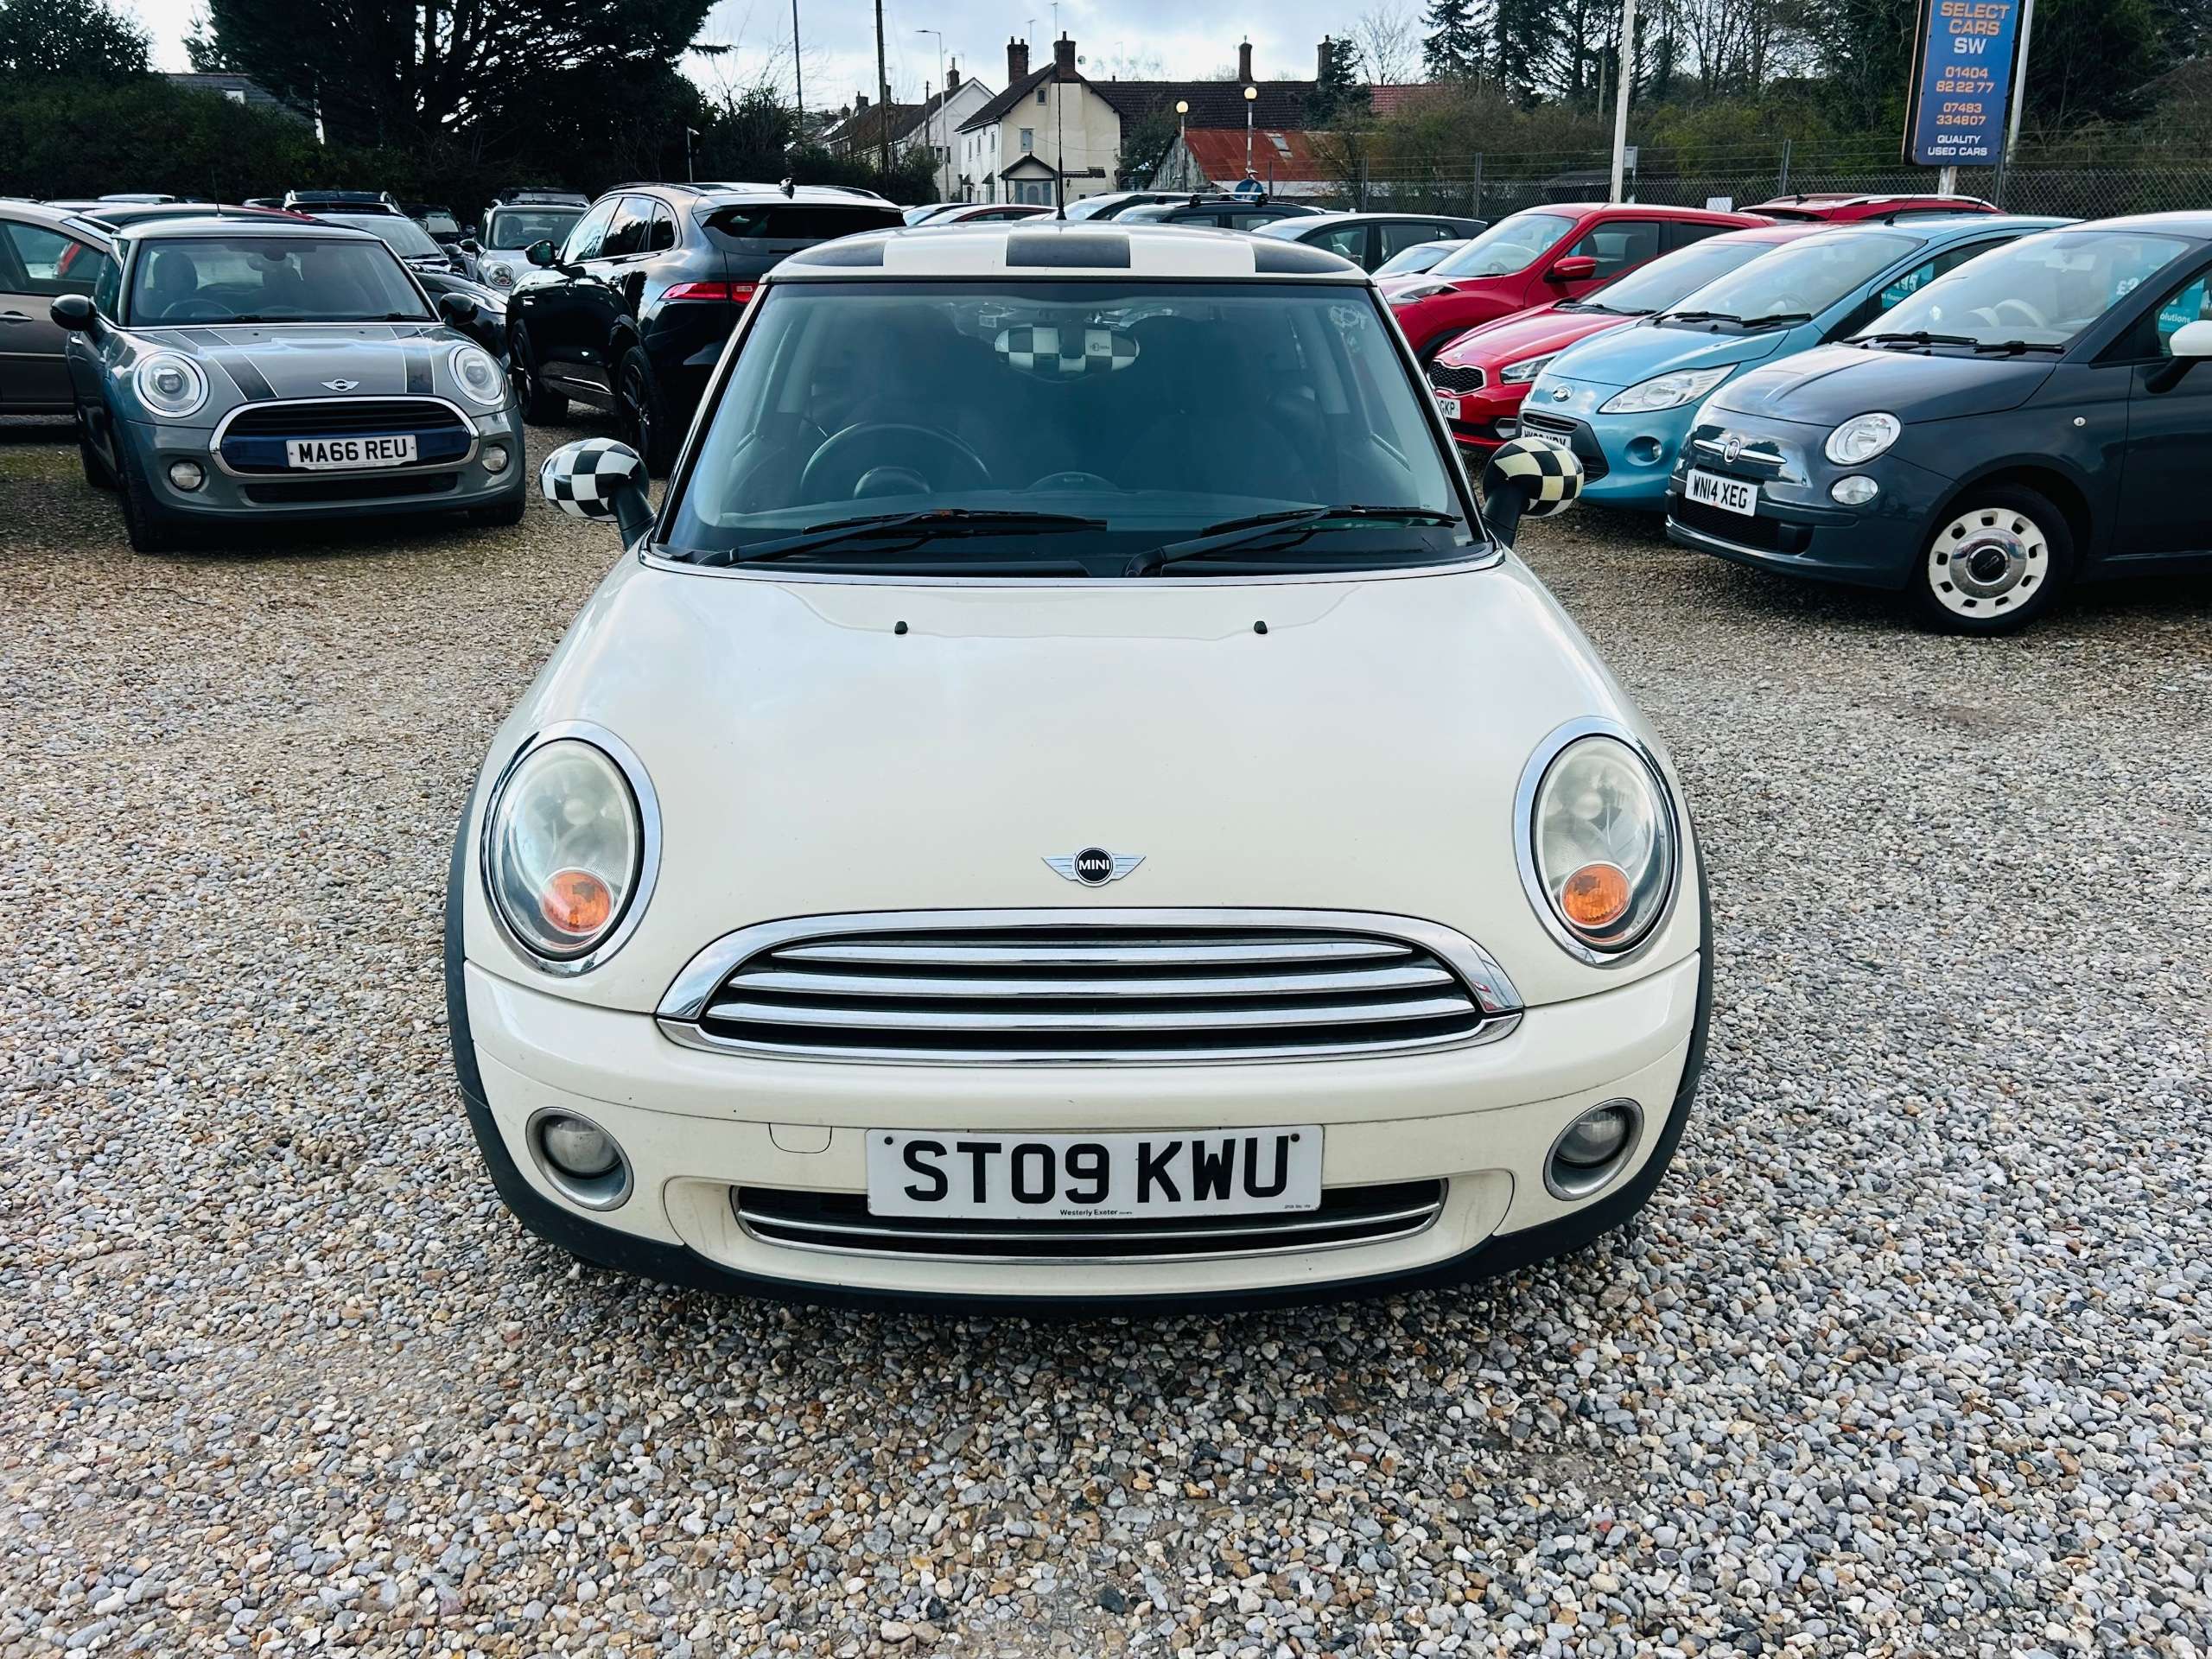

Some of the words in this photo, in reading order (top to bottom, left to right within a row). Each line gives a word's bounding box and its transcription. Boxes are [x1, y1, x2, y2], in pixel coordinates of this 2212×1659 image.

[1941, 2, 2010, 19] SELECT
[1949, 19, 2000, 35] CARS
[1954, 37, 1987, 54] SW
[1945, 67, 1988, 79] 01404
[1943, 102, 1982, 113] 07483
[1936, 115, 1986, 125] 334807
[1937, 135, 1981, 144] QUALITY
[1928, 147, 1956, 156] USED
[1959, 147, 1987, 156] CARS
[2160, 312, 2190, 323] olutions
[298, 442, 359, 463] MA66
[365, 439, 407, 460] REU
[1693, 475, 1718, 501] WN14
[1721, 483, 1748, 509] XEG
[1078, 860, 1110, 870] MINI
[903, 1141, 1109, 1204] ST09
[1137, 1135, 1289, 1203] KWU
